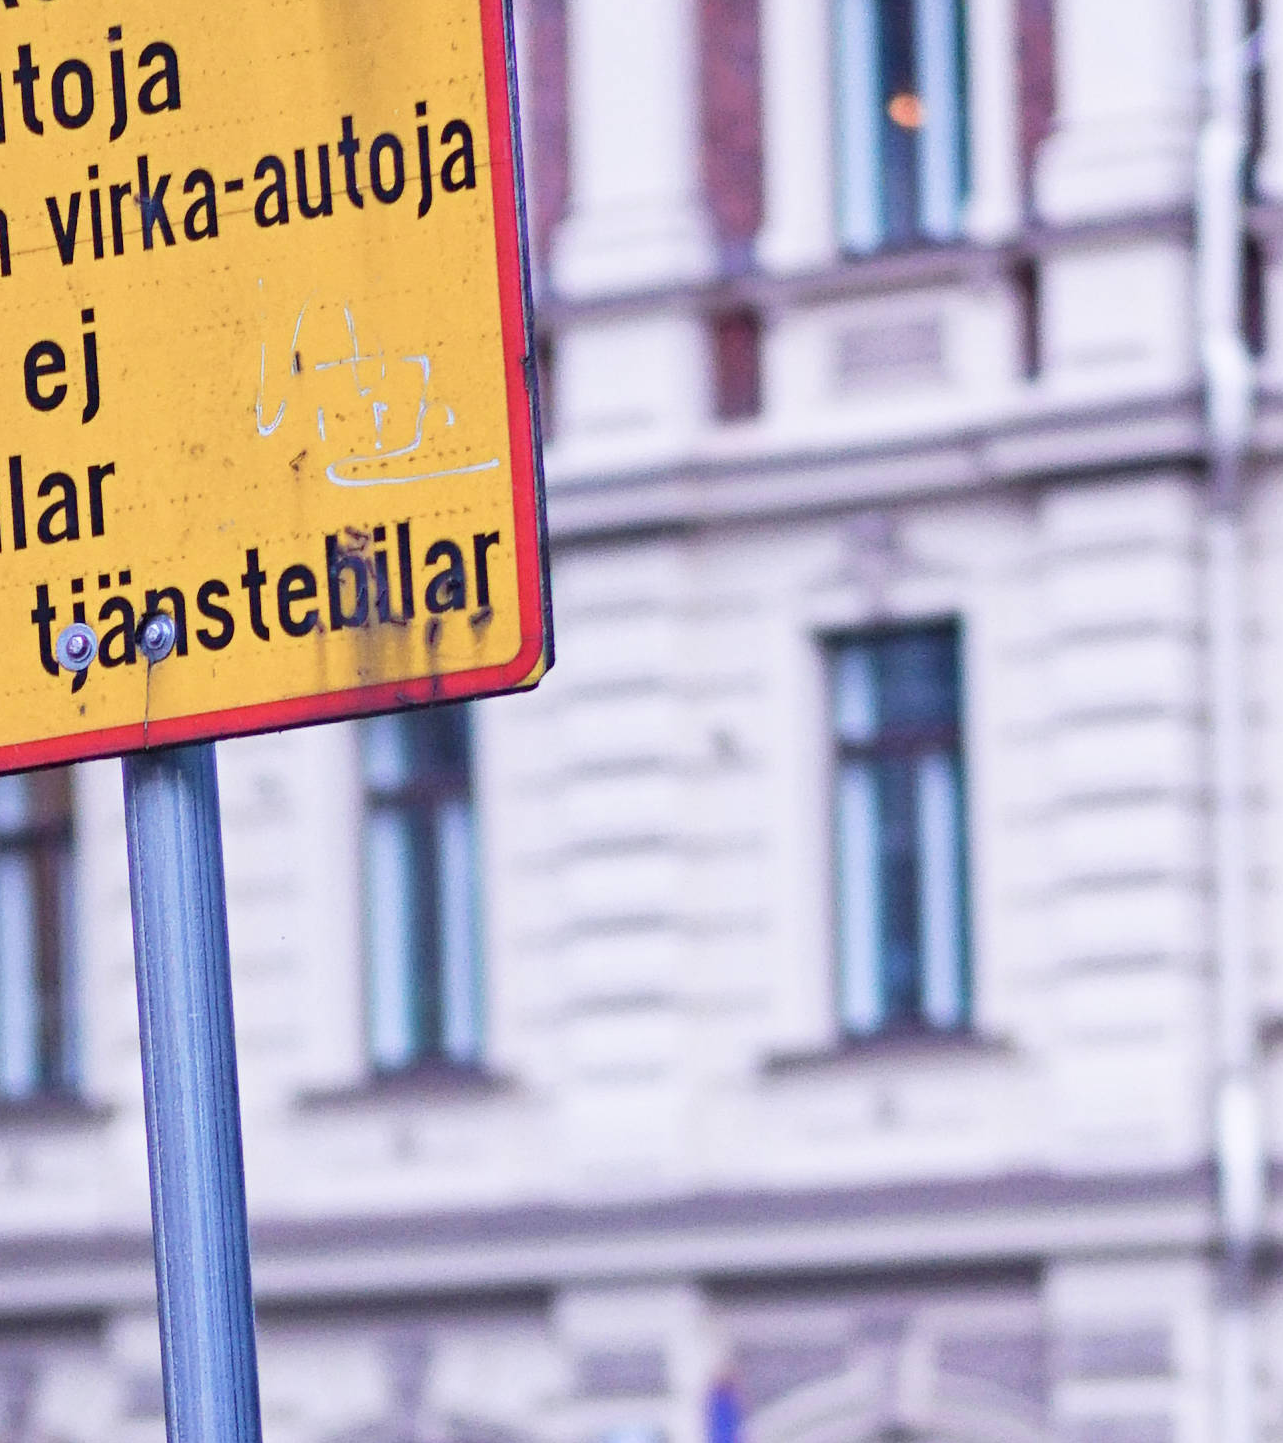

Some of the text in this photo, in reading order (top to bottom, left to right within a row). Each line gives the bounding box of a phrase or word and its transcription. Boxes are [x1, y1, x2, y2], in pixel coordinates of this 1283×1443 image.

[45, 101, 476, 266] virka-autoja
[23, 308, 100, 424] ej
[31, 519, 500, 694] tjänstebilar
